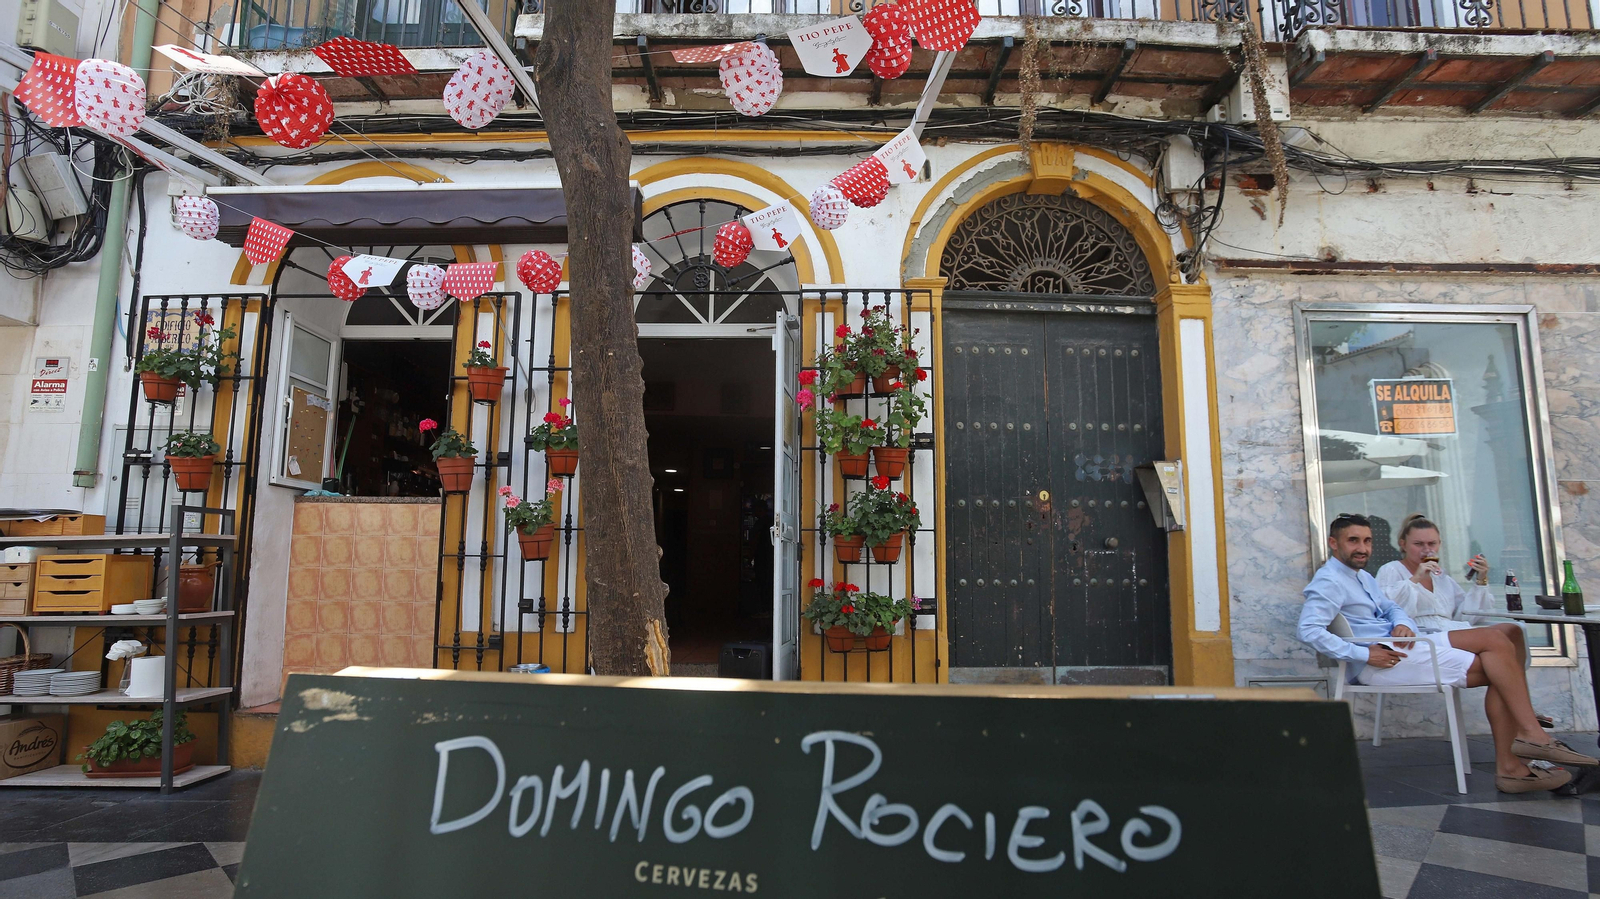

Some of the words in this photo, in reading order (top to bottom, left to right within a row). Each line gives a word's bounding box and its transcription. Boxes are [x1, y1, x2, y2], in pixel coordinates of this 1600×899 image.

[797, 31, 820, 42] TIO
[822, 22, 854, 36] PEPE
[880, 147, 894, 160] TIO
[893, 134, 912, 150] PEPE
[750, 214, 765, 224] TIO
[766, 205, 788, 219] PEPE
[1019, 275, 1064, 294] 1871
[33, 380, 66, 388] Alarma
[1375, 385, 1392, 401] SE
[1394, 384, 1451, 401] ALQUILA
[9, 735, 54, 756] Andrés
[430, 735, 754, 844] DOMINGO
[801, 730, 1182, 873] ROCIERO
[634, 861, 759, 894] CERVEZAS
